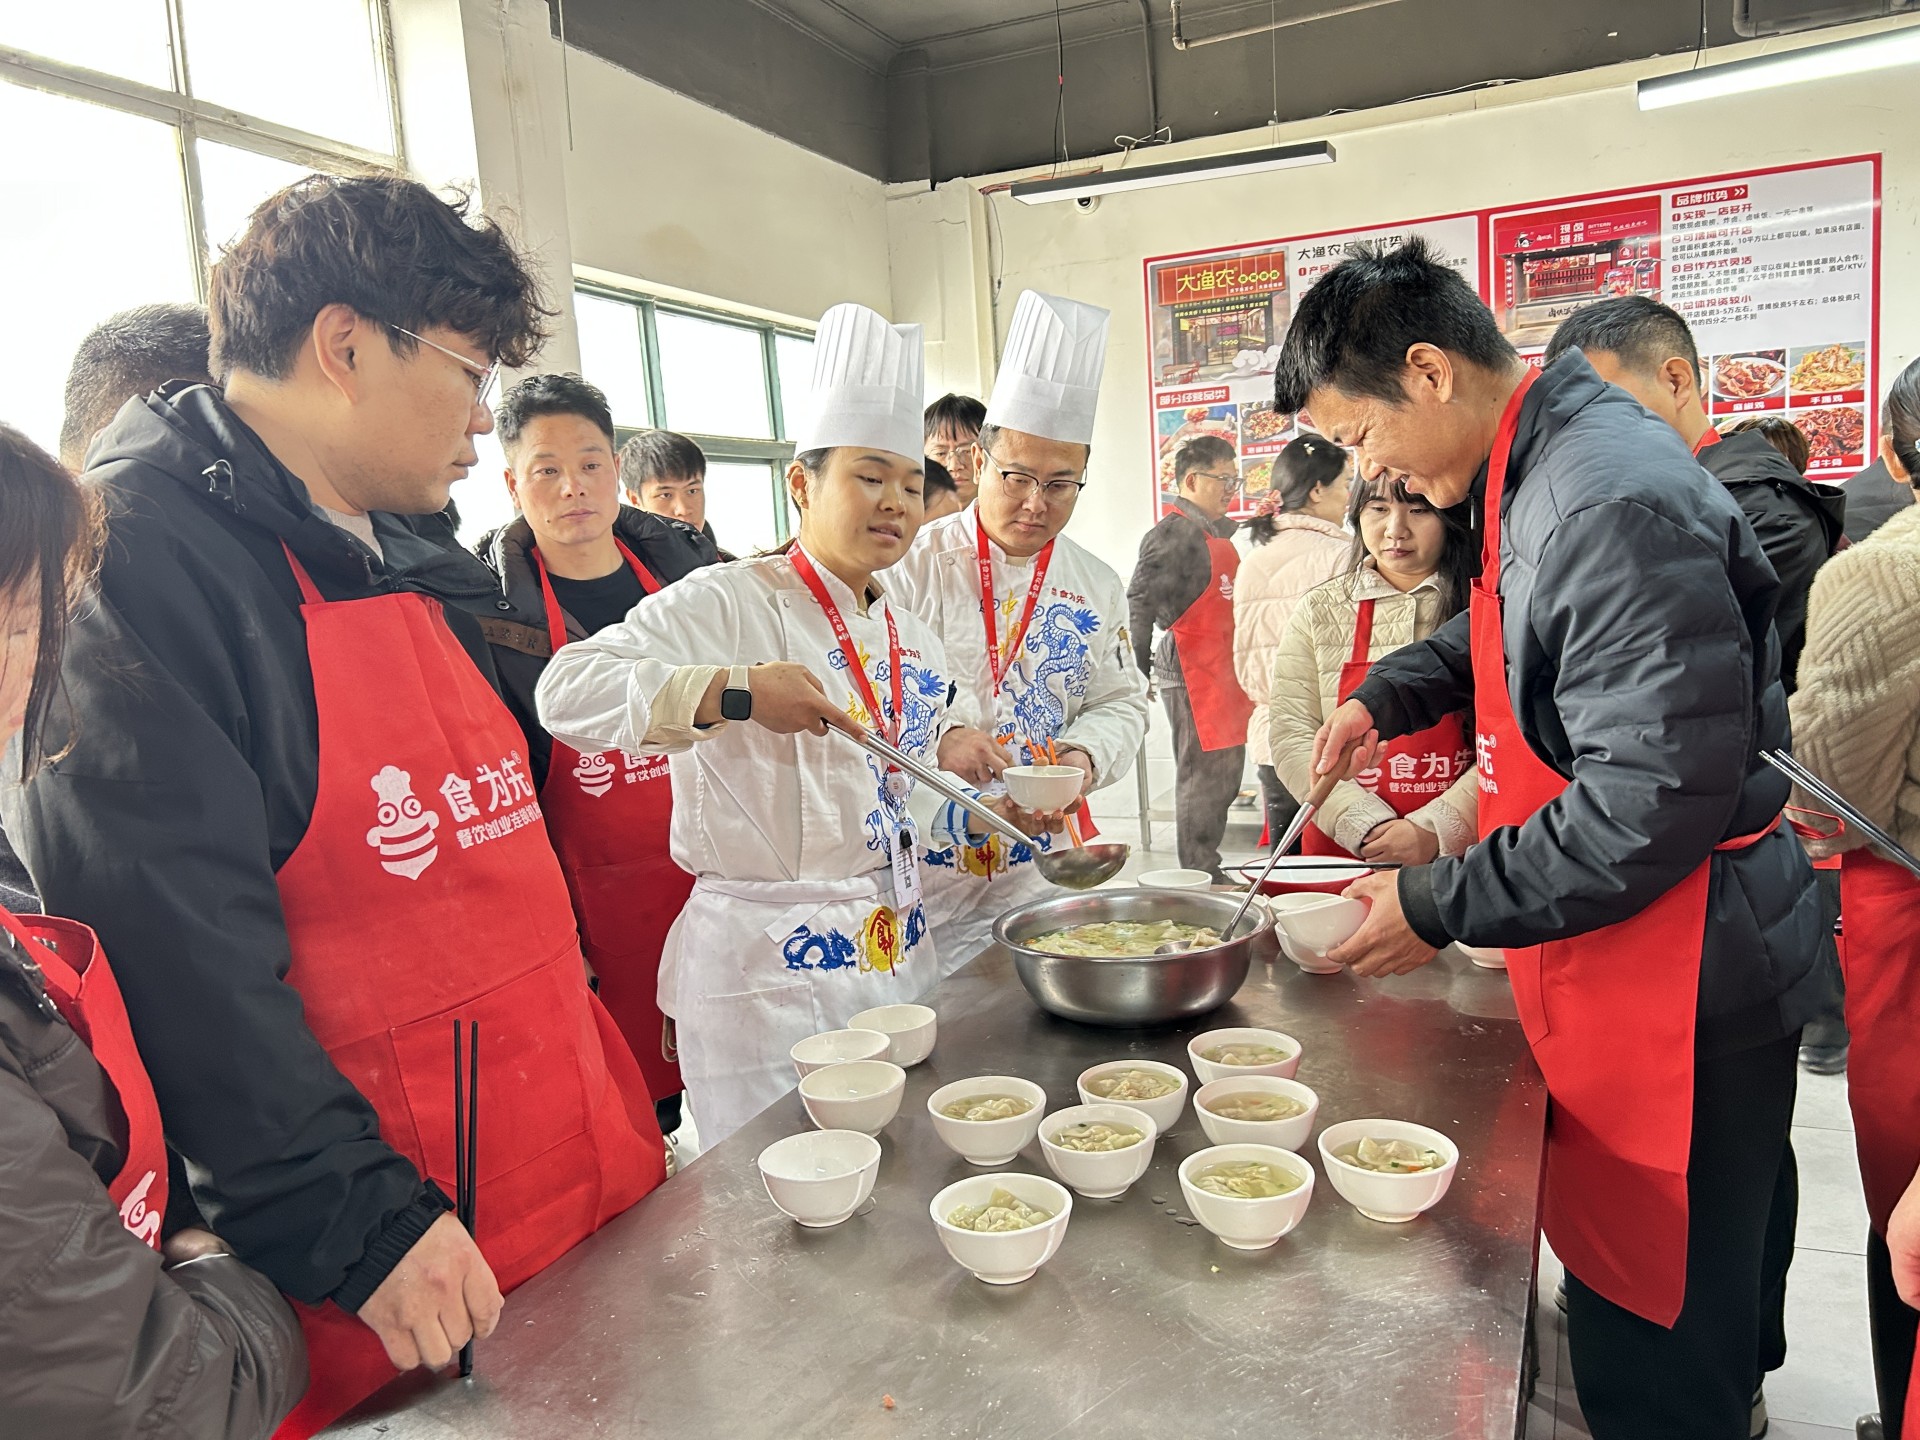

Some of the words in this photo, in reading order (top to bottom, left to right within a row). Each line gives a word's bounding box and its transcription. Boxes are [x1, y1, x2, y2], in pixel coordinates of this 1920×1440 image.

[1676, 190, 1728, 206] 品牌优势
[1177, 268, 1235, 293] 大渔农
[1159, 389, 1227, 406] 部分经营品类
[1059, 589, 1086, 605] 食为先
[439, 757, 534, 823] 食为先
